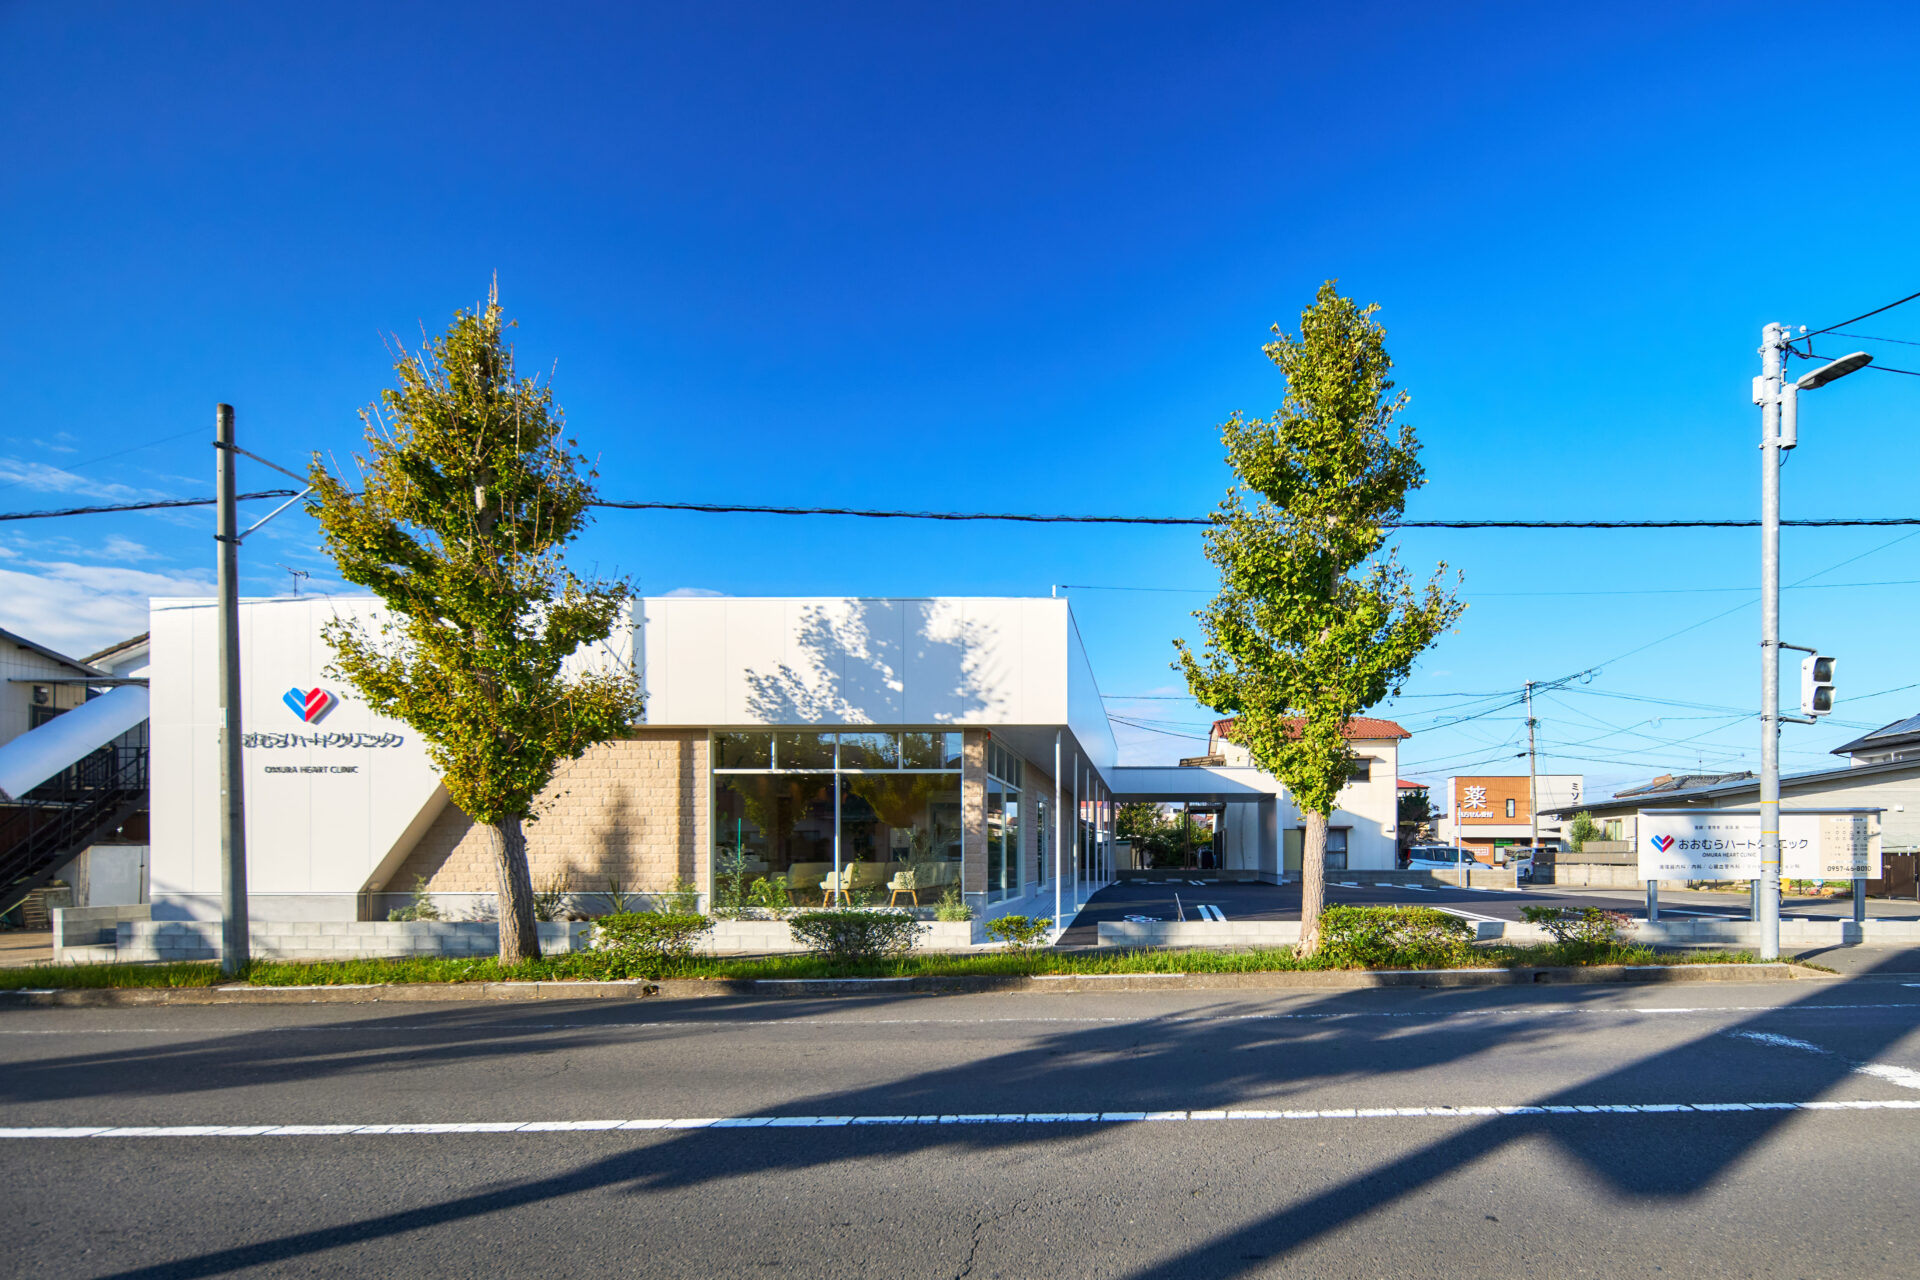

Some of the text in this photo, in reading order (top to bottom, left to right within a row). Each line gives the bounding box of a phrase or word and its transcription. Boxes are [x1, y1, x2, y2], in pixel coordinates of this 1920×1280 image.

[1463, 785, 1487, 809] 薬
[1678, 839, 1808, 850] おおむらハートニック
